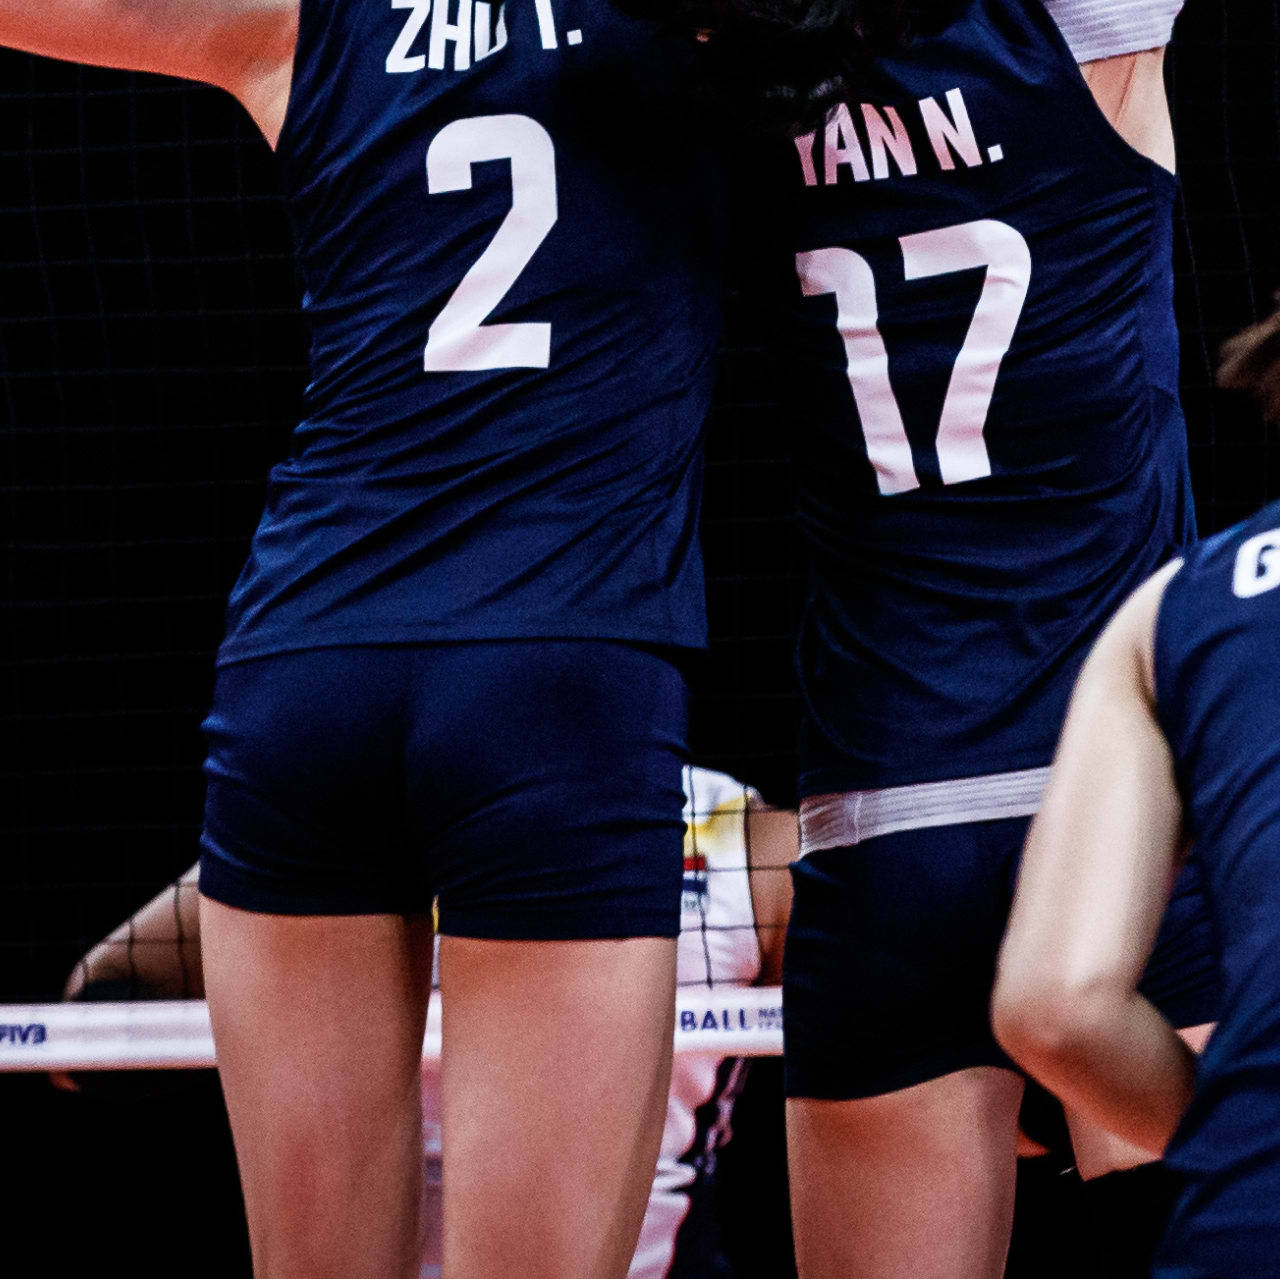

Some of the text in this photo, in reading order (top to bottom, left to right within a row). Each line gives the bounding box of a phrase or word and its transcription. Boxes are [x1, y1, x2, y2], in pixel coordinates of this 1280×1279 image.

[423, 113, 559, 372] 2
[917, 87, 1004, 172] N.
[795, 218, 1033, 496] 17
